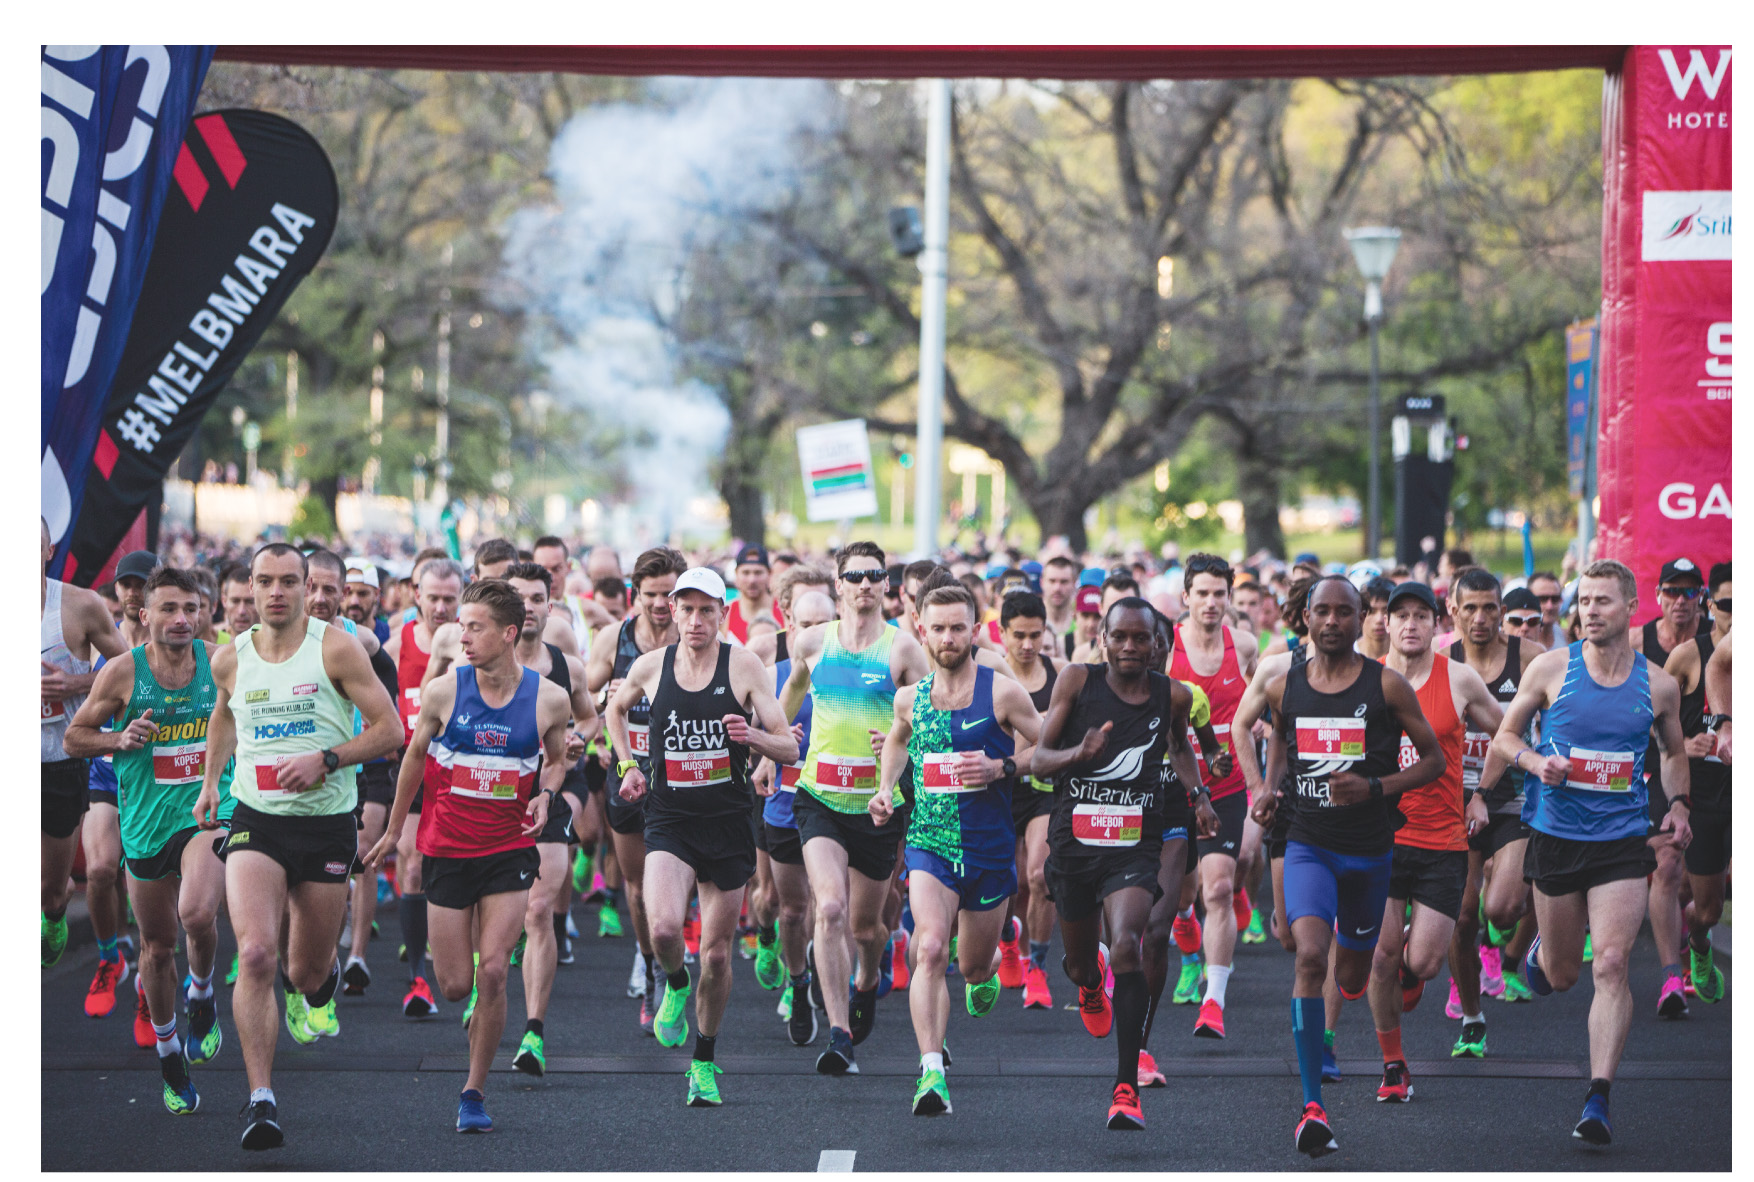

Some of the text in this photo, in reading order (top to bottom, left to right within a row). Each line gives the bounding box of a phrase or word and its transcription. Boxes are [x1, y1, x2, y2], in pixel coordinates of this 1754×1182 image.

[116, 202, 316, 453] #MELBMARA
[254, 721, 297, 740] HOKA
[682, 719, 723, 735] run
[665, 733, 725, 751] crew
[1317, 729, 1341, 742] BIRIR
[1325, 741, 1333, 753] 3
[174, 753, 200, 767] KOPEC
[681, 760, 713, 771] HUDSON
[185, 764, 191, 776] 9
[837, 765, 853, 777] COX
[1584, 761, 1621, 774] APPLEBY
[470, 768, 502, 782] THORPE
[949, 775, 960, 786] 12
[1070, 777, 1154, 808] SriLankan
[1091, 816, 1124, 828] CHEBOR
[1104, 828, 1110, 839] 4
